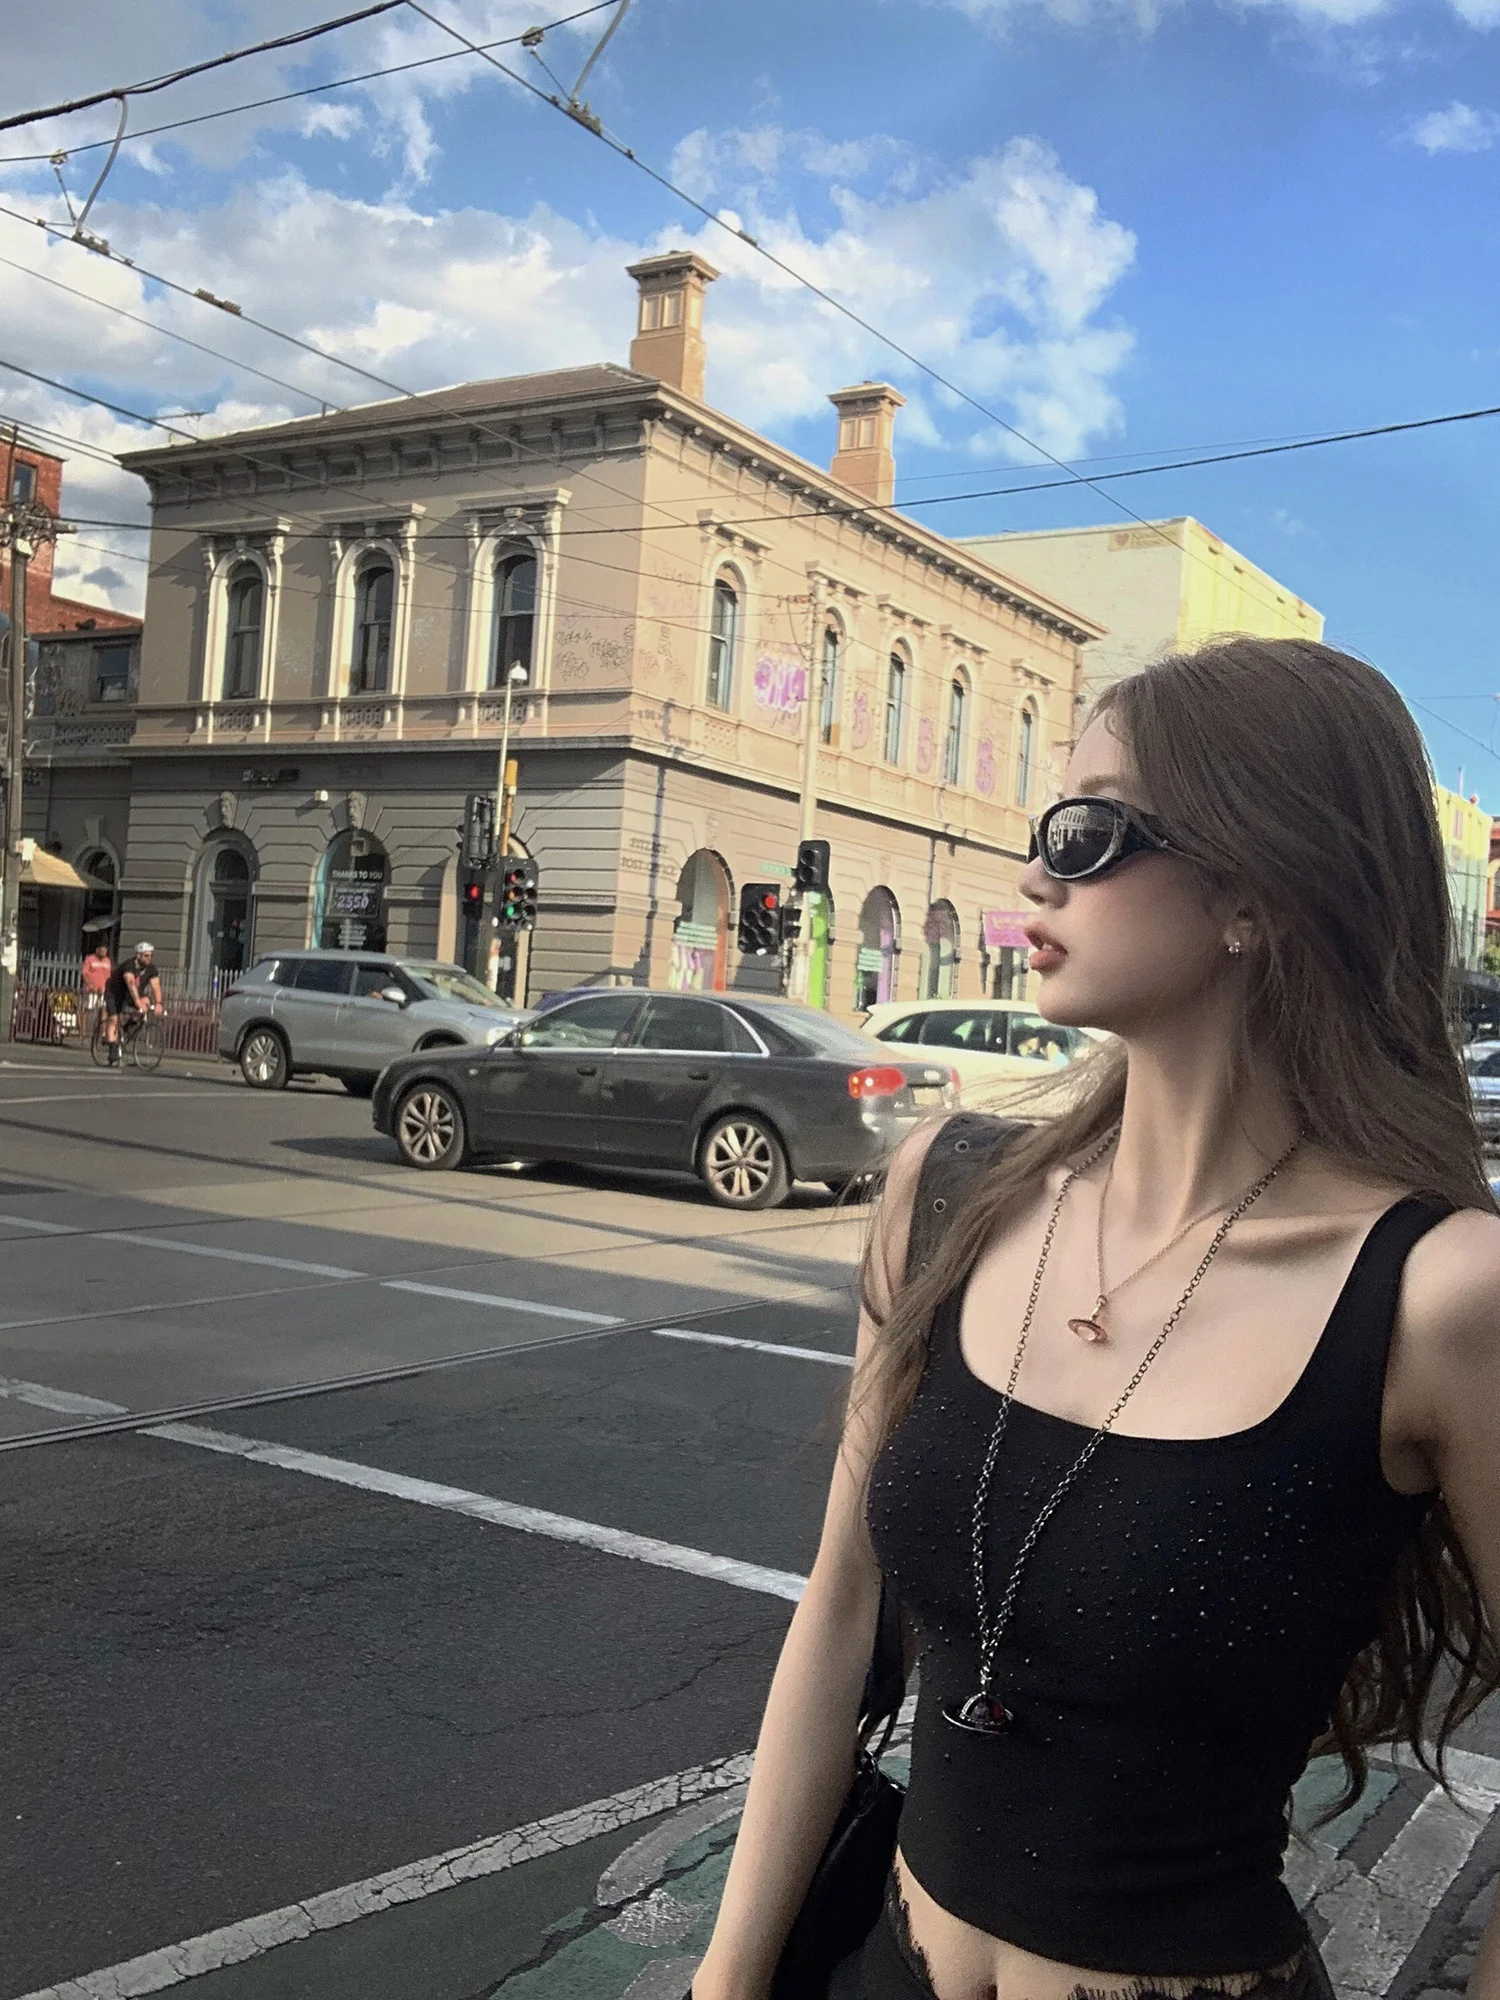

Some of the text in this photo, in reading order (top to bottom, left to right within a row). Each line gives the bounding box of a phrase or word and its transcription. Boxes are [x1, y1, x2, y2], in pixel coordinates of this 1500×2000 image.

[629, 838, 670, 855] FITZY
[620, 857, 644, 870] POST
[359, 870, 368, 880] TO
[369, 871, 383, 880] YOU
